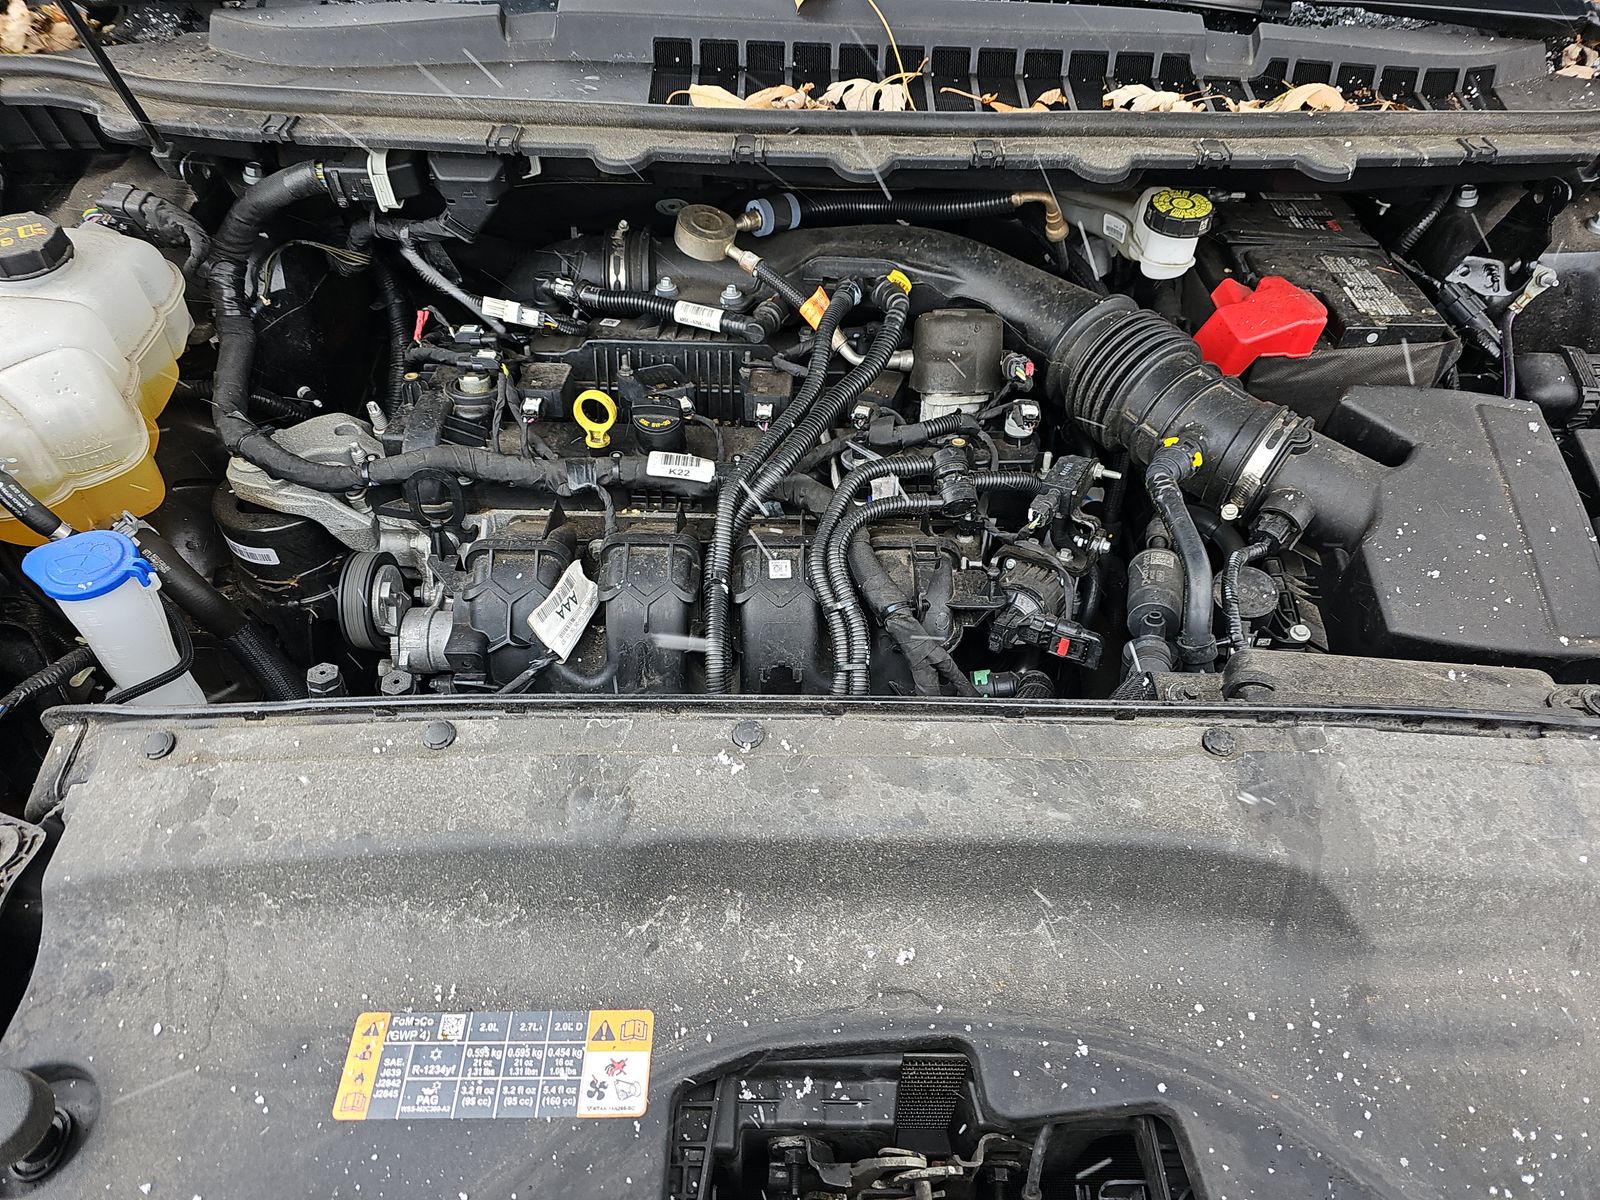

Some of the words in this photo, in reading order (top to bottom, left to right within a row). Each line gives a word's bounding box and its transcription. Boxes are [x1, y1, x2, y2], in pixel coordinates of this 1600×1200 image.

[668, 468, 691, 477] K22
[555, 590, 579, 620] AAA
[392, 1016, 435, 1027] FoMoCo
[519, 1022, 539, 1031] 2.7L
[554, 1022, 574, 1031] 2.0L
[575, 1022, 583, 1031] D
[479, 1022, 498, 1032] 2.0L
[386, 1030, 418, 1041] (GWP
[419, 1030, 431, 1041] 4)
[491, 1048, 502, 1060] kg
[532, 1048, 543, 1059] kg
[547, 1048, 570, 1058] 0.454
[572, 1048, 583, 1059] kg
[383, 1057, 404, 1067] SAE
[472, 1059, 482, 1067] 21
[513, 1059, 523, 1067] 21
[411, 1065, 457, 1076] R-1234yf
[509, 1067, 523, 1076] 1.31
[484, 1087, 495, 1095] oz
[525, 1087, 537, 1095] oz
[542, 1086, 557, 1095] 5.4
[557, 1085, 565, 1094] fl
[566, 1087, 577, 1095] oz
[416, 1095, 439, 1105] PAG
[477, 1096, 492, 1108] cc)
[503, 1096, 518, 1108] (95
[519, 1096, 534, 1108] cc)
[541, 1096, 561, 1108] (160
[562, 1096, 577, 1108] cc)
